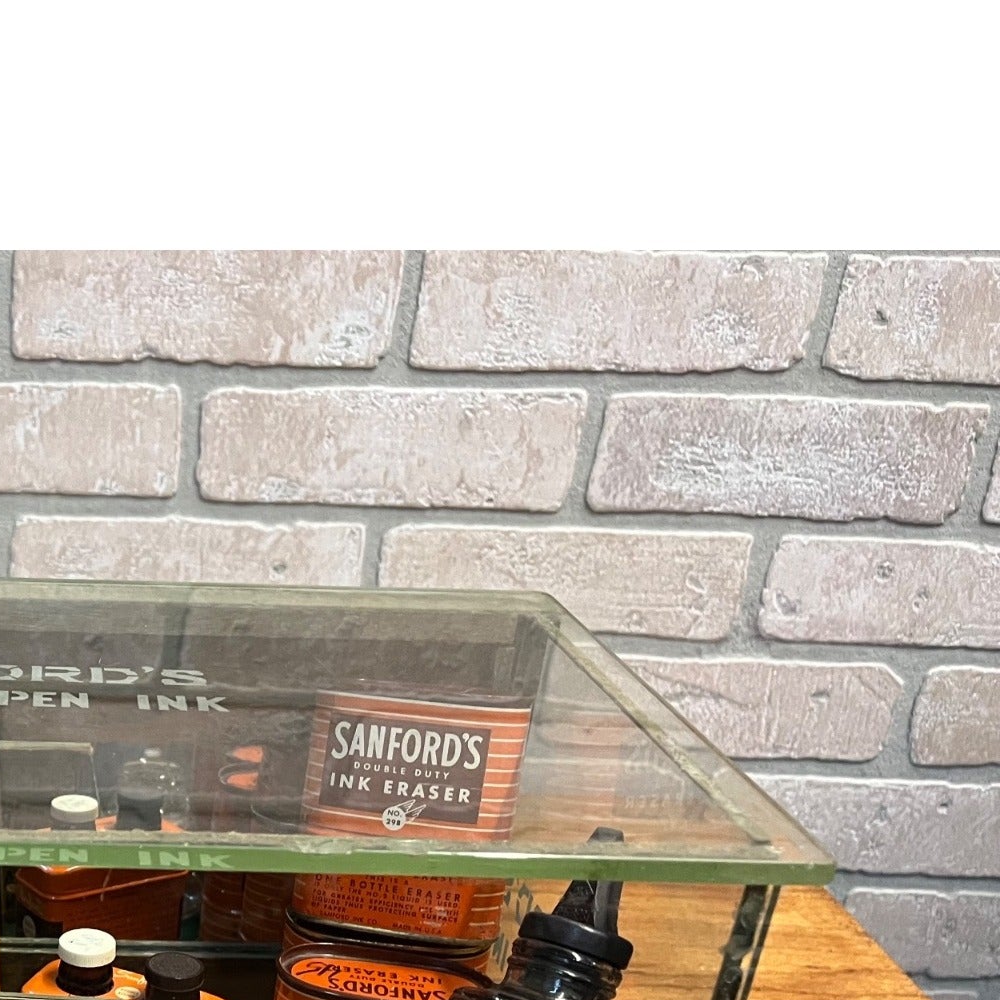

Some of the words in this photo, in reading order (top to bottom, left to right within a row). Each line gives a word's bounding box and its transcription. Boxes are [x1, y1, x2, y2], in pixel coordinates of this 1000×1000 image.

[136, 694, 230, 713] INK
[331, 720, 484, 770] SANFORD'S
[354, 761, 406, 776] DOUBLE
[415, 768, 451, 780] DUTY
[330, 772, 371, 792] INK
[383, 780, 471, 804] ERASER
[138, 850, 236, 869] INK
[350, 878, 398, 894] BOTTLE
[407, 887, 461, 902] ERASER
[349, 974, 376, 982] DUTY
[381, 978, 425, 988] DOUBLE
[410, 974, 442, 985] INK
